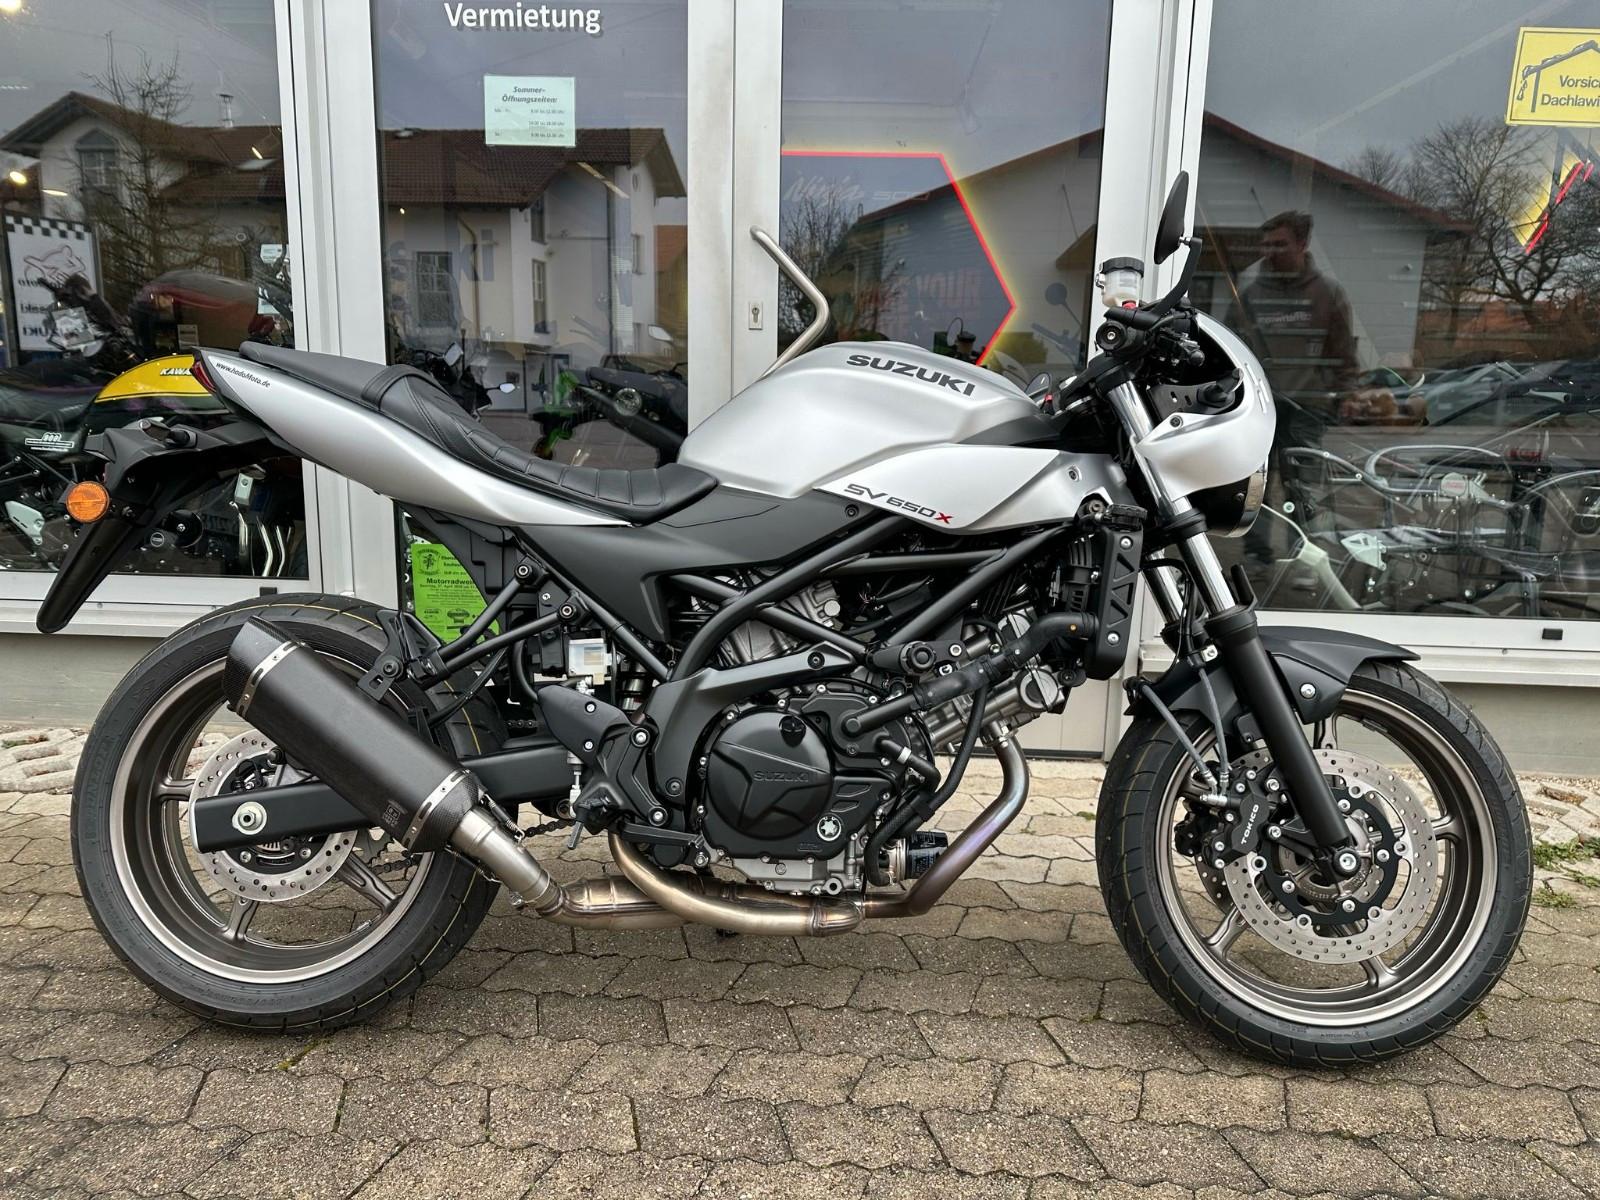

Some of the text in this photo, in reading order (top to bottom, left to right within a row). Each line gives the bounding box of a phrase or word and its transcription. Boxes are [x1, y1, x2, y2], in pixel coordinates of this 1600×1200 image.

[444, 2, 601, 34] Vermietung
[1560, 75, 1600, 88] Vorsic
[160, 367, 192, 376] KAWA
[846, 354, 976, 397] SUZUKI
[753, 770, 809, 782] SUZUKI
[1240, 803, 1260, 845] TOKICO
